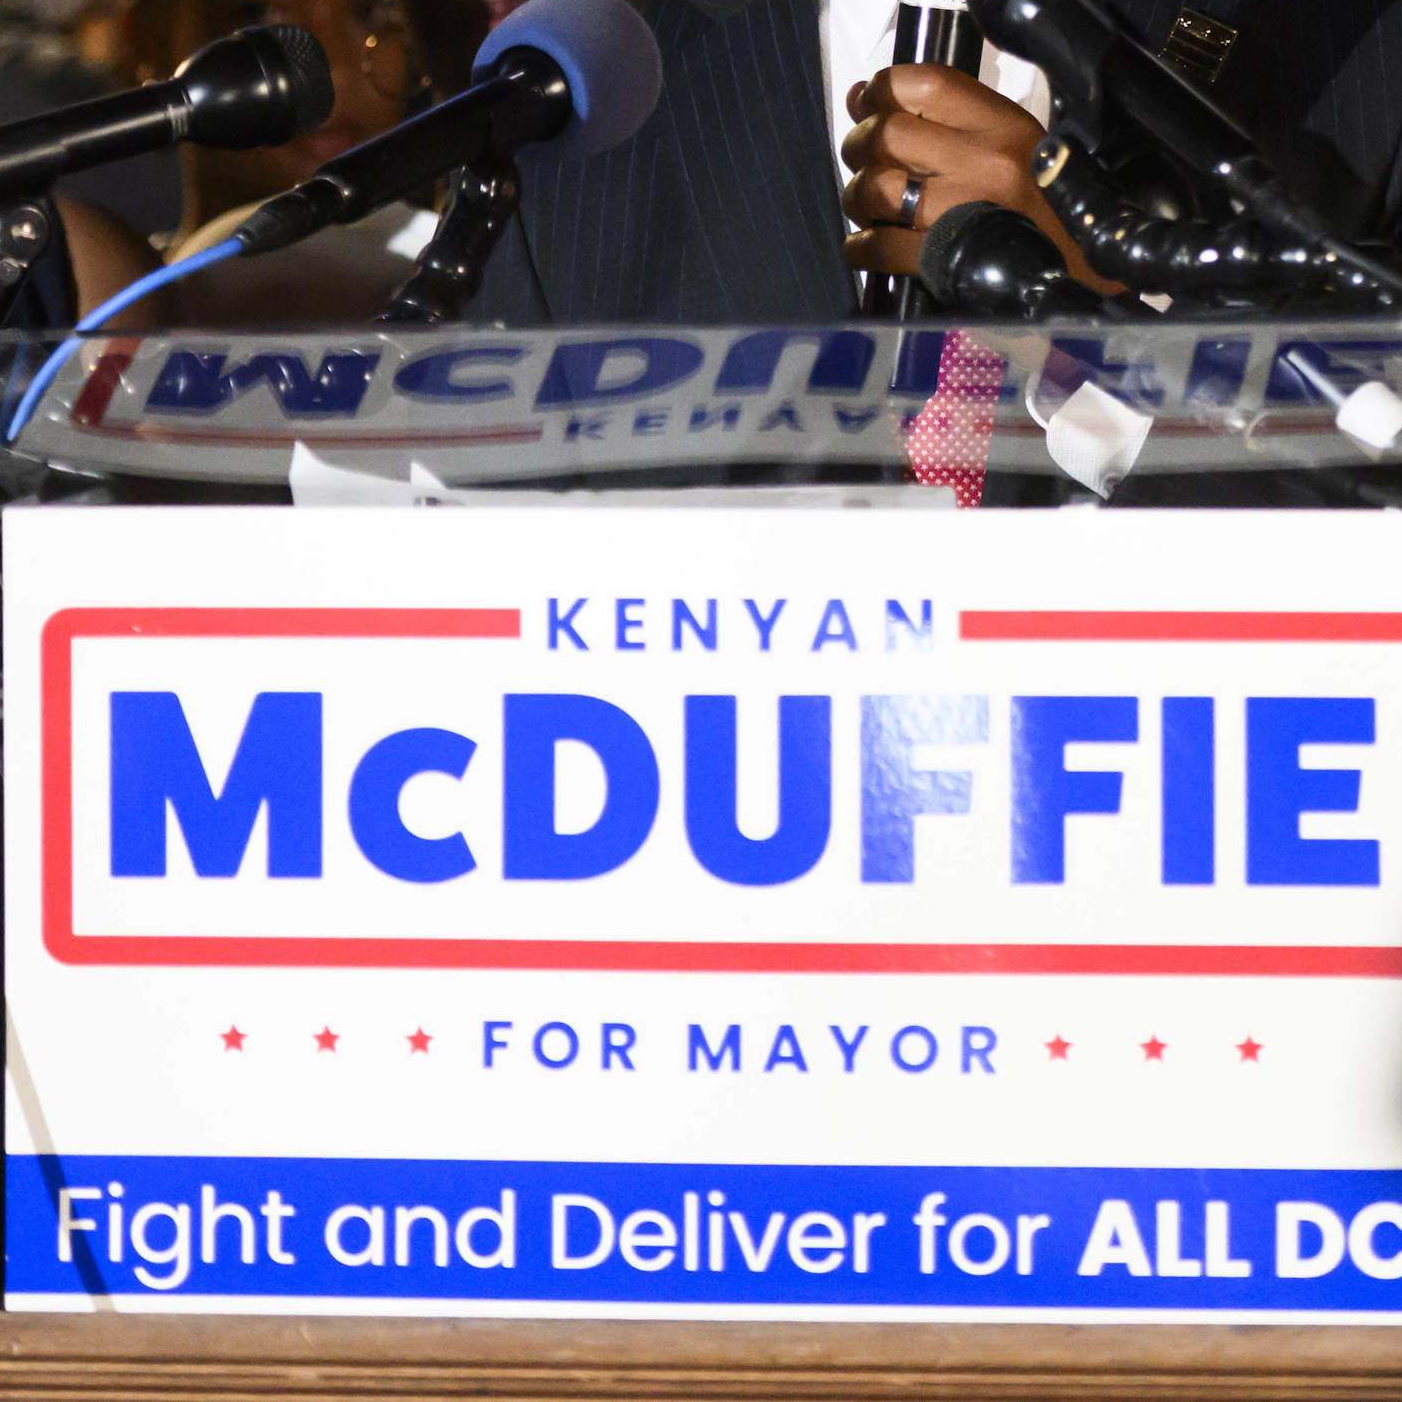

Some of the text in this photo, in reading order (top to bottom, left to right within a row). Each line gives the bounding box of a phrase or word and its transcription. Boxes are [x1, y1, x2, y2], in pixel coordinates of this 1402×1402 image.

[547, 597, 934, 653] KENYAN
[109, 690, 1382, 888] McDUFFIE
[483, 1021, 998, 1073] FOR MAYOR
[58, 1181, 296, 1290] Fight
[324, 1188, 517, 1269] and
[551, 1189, 887, 1274] Deliver
[912, 1191, 1052, 1276] for
[1077, 1198, 1253, 1278] ALL
